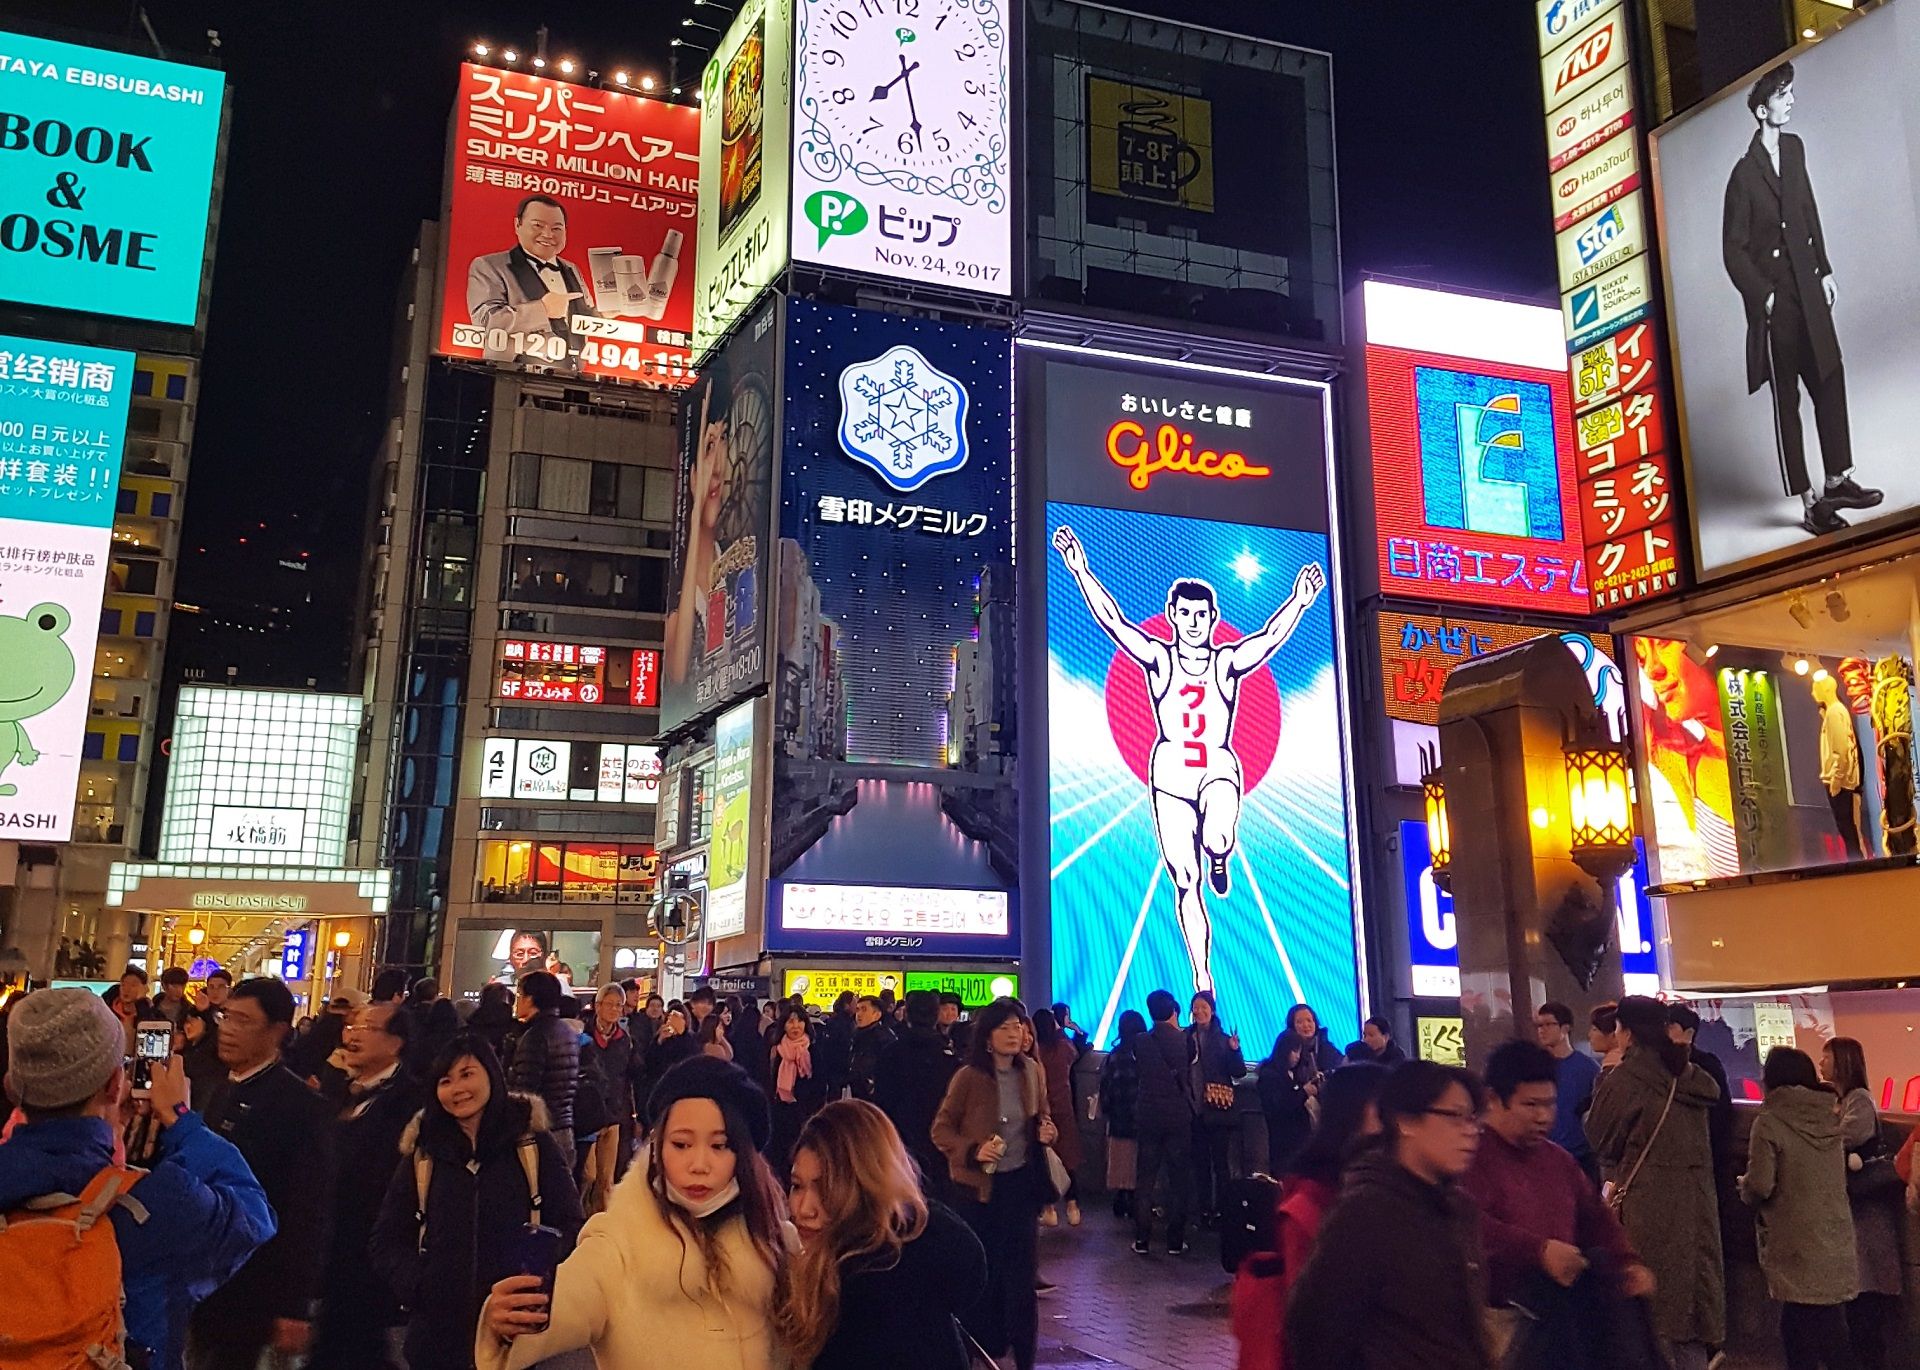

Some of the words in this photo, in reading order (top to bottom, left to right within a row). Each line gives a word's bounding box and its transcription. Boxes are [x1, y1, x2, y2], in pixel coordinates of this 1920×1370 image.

[830, 11, 858, 39] 10
[935, 14, 948, 31] 1
[822, 49, 845, 67] 9
[954, 44, 976, 62] 2
[1559, 30, 1611, 87] TKP
[66, 67, 203, 105] EBISUBASHI
[469, 73, 605, 118] スーパー
[832, 88, 855, 104] 8
[964, 80, 986, 96] 3
[1581, 84, 1624, 121] 하나투어
[468, 104, 700, 164] ミリオンヘアー
[862, 116, 884, 134] 7
[956, 110, 977, 130] 4
[0, 111, 154, 173] BOOK
[897, 132, 914, 154] 6
[932, 129, 950, 152] 5
[466, 138, 549, 168] SUPER
[556, 154, 642, 184] MILLION
[1581, 148, 1632, 185] HanaTour
[46, 171, 87, 211] &
[465, 165, 698, 219] 薄毛部分のボリュームアップ
[879, 205, 962, 247] ピップ
[875, 247, 919, 268] Nov.
[922, 257, 951, 276] 24,
[955, 261, 1001, 282] 2017
[1574, 268, 1590, 284] STA
[1591, 254, 1620, 275] TRAVEL
[1601, 273, 1629, 291] NIKKEN
[1602, 286, 1626, 300] TOTAL
[1603, 286, 1641, 311] SOURCING
[576, 319, 619, 335] ルアン
[1579, 357, 1615, 397] 5F
[0, 384, 109, 407] スメ大賞の化粧品
[0, 421, 24, 438] 00
[31, 424, 111, 448] 日元以上
[1617, 323, 1671, 564] インターネット
[1105, 420, 1275, 491] Glico
[818, 495, 988, 536] 雪印メグミルク
[1586, 442, 1627, 577] コミック
[0, 562, 84, 578] ランキング化粧品
[1400, 621, 1492, 656] かぜに
[501, 681, 521, 697] 5F
[1178, 680, 1208, 768] グリコ
[195, 895, 232, 907] EBISU
[865, 936, 923, 948] 雪印メグミルク
[722, 979, 756, 991] Toilets
